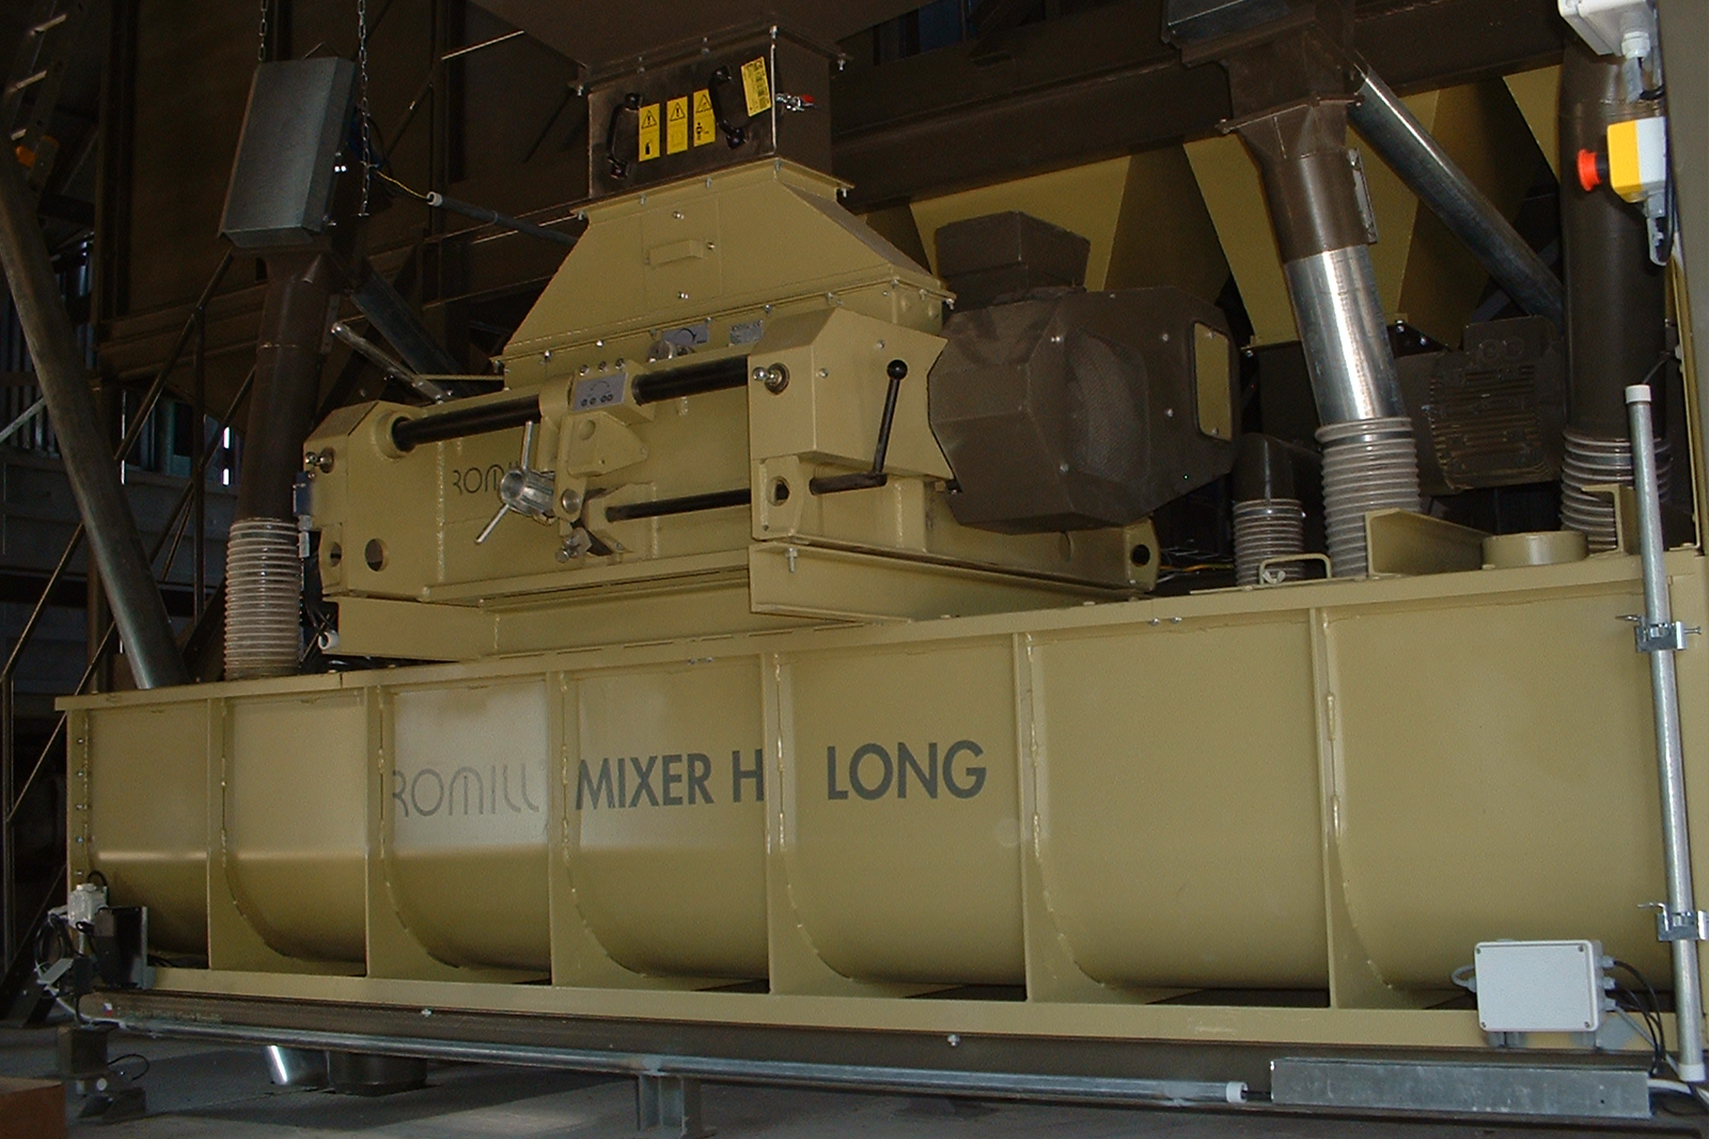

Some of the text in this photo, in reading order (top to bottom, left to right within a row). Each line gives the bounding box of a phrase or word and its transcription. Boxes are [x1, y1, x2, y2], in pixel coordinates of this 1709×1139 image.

[576, 752, 715, 811] MIXER
[732, 748, 765, 803] H
[827, 740, 987, 801] LONG
